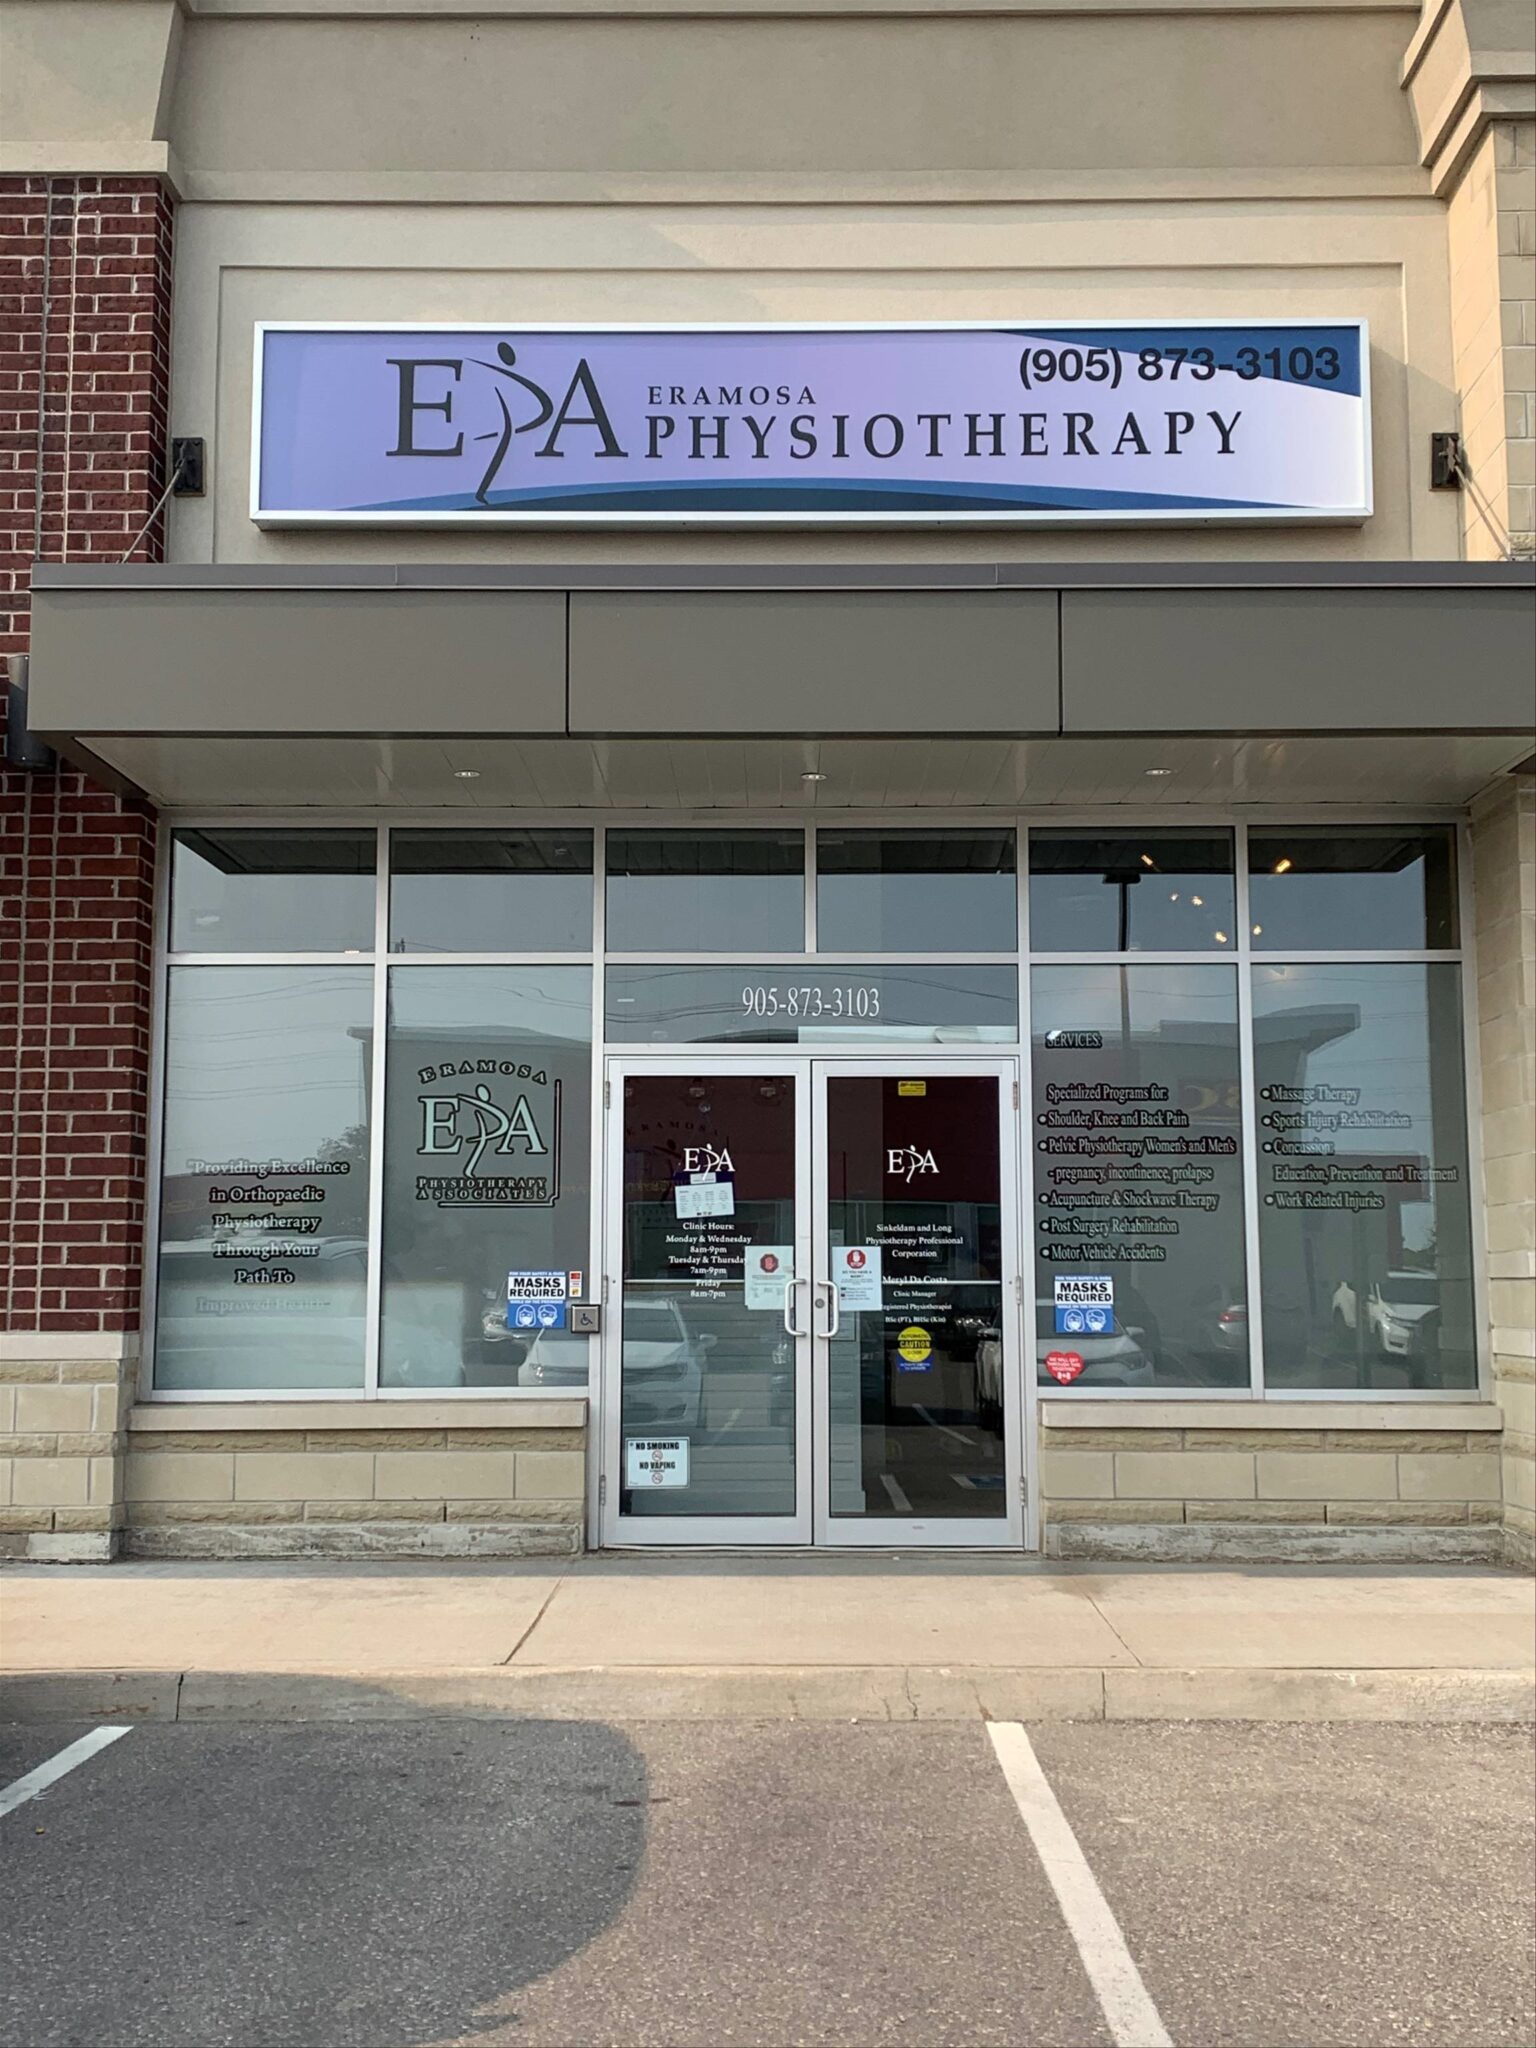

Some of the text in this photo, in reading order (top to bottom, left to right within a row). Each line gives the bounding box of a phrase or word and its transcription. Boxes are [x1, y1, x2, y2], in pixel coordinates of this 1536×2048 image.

[1019, 346, 1341, 390] (905) 873-3103
[647, 385, 817, 406] ERAMOSA
[644, 410, 1243, 460] PHYSIOTHERAPY
[742, 986, 880, 1017] 905-873-3103
[418, 1060, 548, 1085] ERAMOSA
[1048, 1084, 1100, 1102] Specialized
[1103, 1086, 1149, 1102] Programs
[1271, 1086, 1359, 1104] Massage Therapy
[1048, 1112, 1188, 1128] Shoulder, Knee and Back Pain
[1272, 1112, 1411, 1131] Sports Injury Rehabilitation
[1049, 1138, 1077, 1153] Pelvic
[1079, 1138, 1144, 1157] Physiotherapy
[1189, 1138, 1206, 1153] and
[271, 1159, 350, 1174] Excellence
[1172, 1165, 1213, 1182] prolapse
[1275, 1165, 1458, 1183] Education, Prevention and Treatment
[417, 1176, 548, 1190] PHYSIOTHERAPY
[210, 1185, 324, 1205] in Orthopaedic
[417, 1188, 548, 1200] ASSOCIATES
[1050, 1191, 1219, 1210] Acupuncture & Shockwave Therapy
[1275, 1193, 1384, 1212] Work Related Injuries
[213, 1214, 321, 1232] Physiotherapy
[683, 1222, 707, 1231] Clinic
[917, 1224, 931, 1232] and
[932, 1224, 952, 1233] Long
[1050, 1217, 1178, 1236] Post Surgery Rehabilitation
[665, 1235, 698, 1244] Monday
[707, 1235, 752, 1245] Wednesday
[866, 1236, 963, 1246] Physiotherapy Professional
[213, 1242, 320, 1260] Through Your
[690, 1246, 727, 1255] 8am-9pm
[892, 1250, 937, 1259] Corporation
[1050, 1245, 1166, 1261] Motor Vehicle Accidents
[668, 1256, 701, 1265] Tuesday
[710, 1256, 747, 1264] Thursda
[236, 1269, 295, 1284] Path To
[690, 1267, 727, 1276] 7am-9pm
[513, 1278, 561, 1288] MASKS
[696, 1279, 721, 1288] Friday
[924, 1276, 948, 1284] Costa
[1060, 1282, 1108, 1293] MASKS
[509, 1288, 565, 1298] REQUIRED
[690, 1290, 726, 1299] 8am-7pm
[1056, 1293, 1112, 1303] REQUIRED
[900, 1340, 931, 1348] CAUTION
[635, 1441, 680, 1450] NO SMOKING
[639, 1461, 676, 1470] NO VAPING
